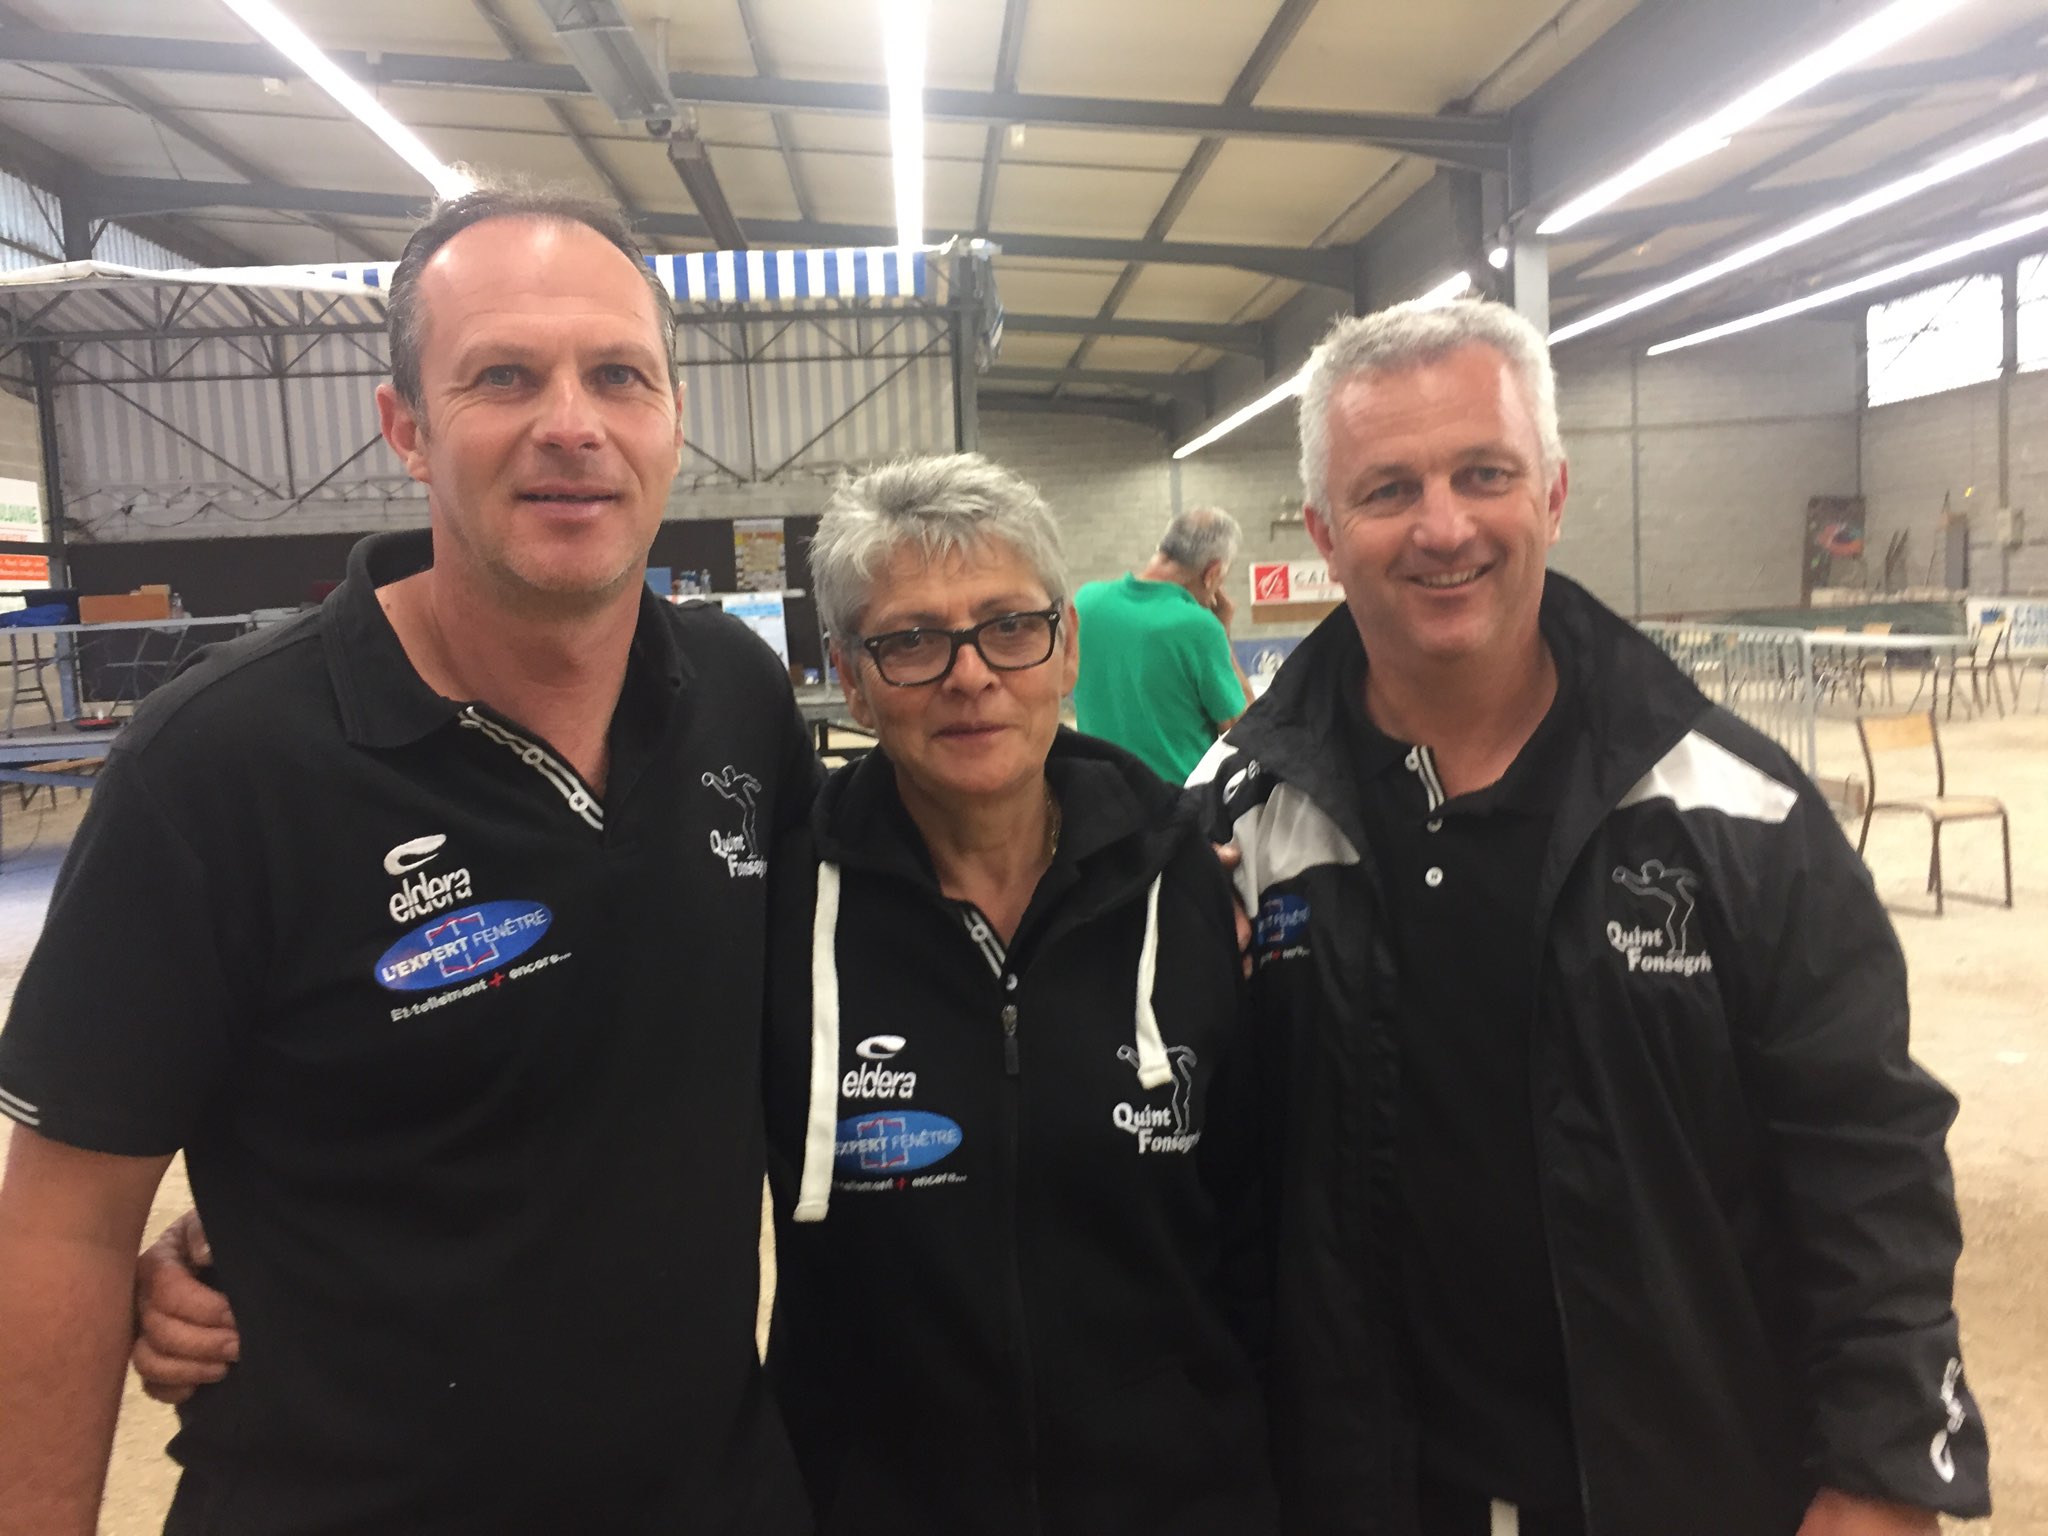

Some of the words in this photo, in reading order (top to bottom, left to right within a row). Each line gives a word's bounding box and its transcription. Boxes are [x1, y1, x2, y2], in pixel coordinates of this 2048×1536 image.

[1295, 570, 1327, 584] CAI
[710, 829, 745, 859] Quint
[389, 868, 472, 923] eldera
[381, 936, 469, 982] L'EXPERT
[472, 908, 548, 947] FENÊTRE
[1606, 920, 1663, 953] Quint
[842, 1062, 917, 1099] eldera
[1113, 1102, 1172, 1135] Quint
